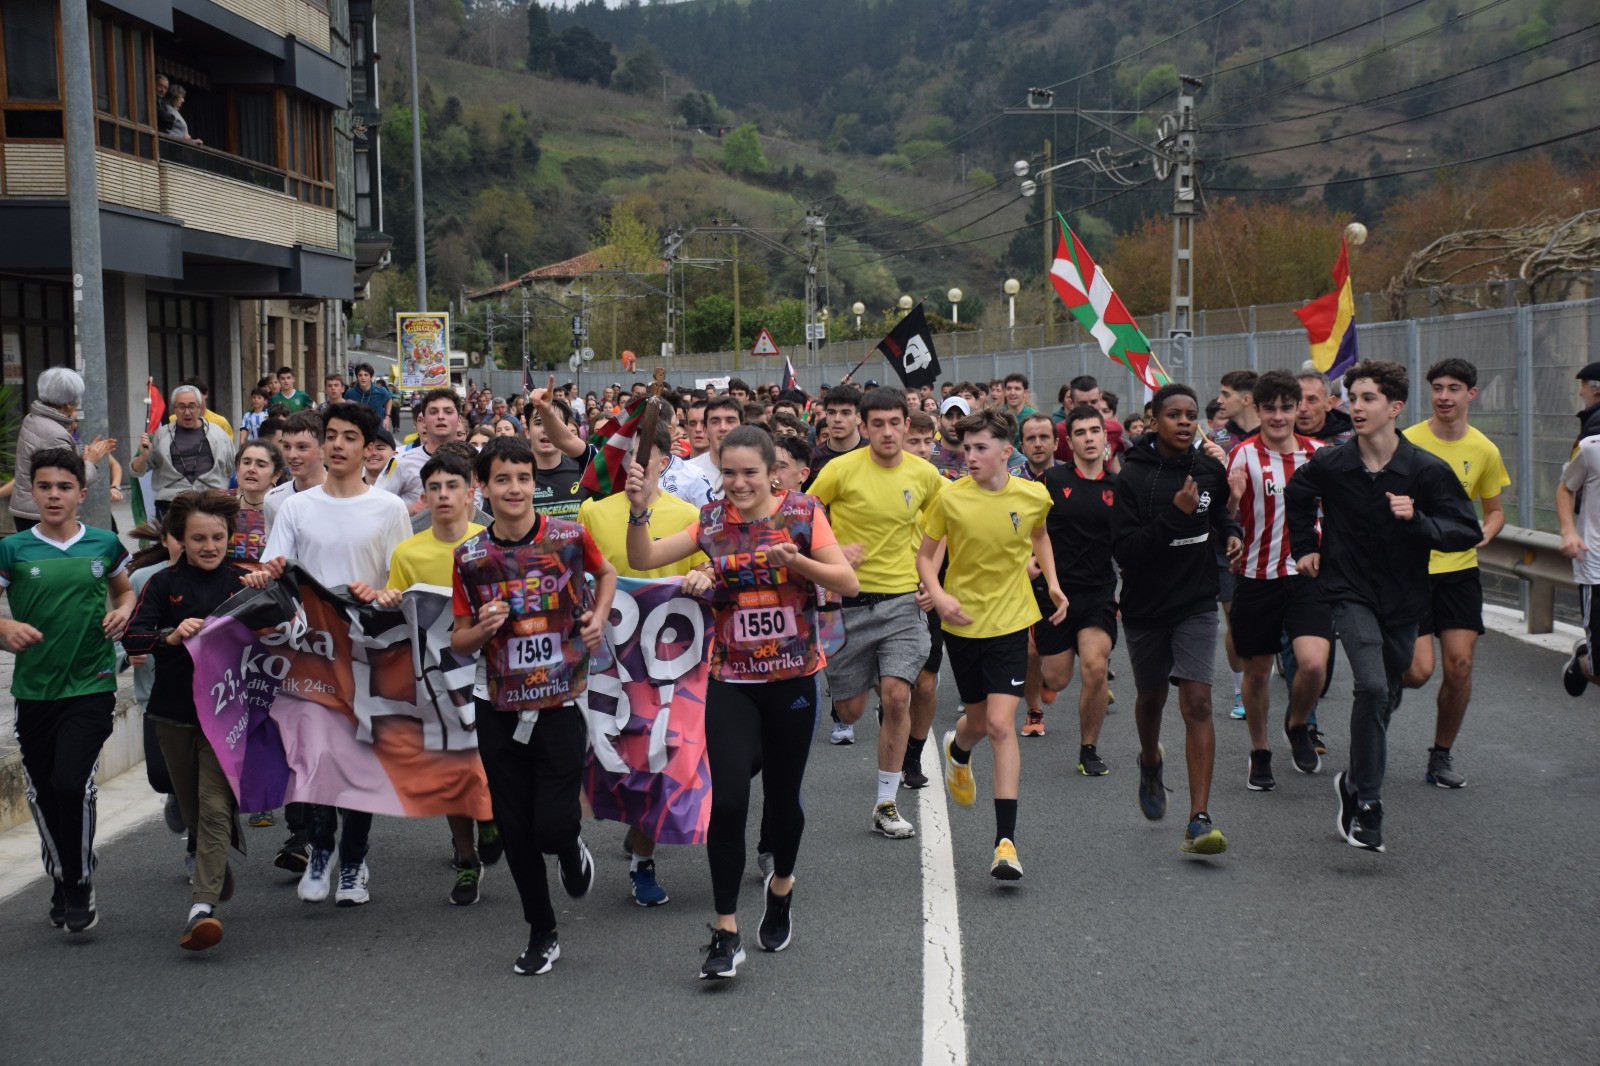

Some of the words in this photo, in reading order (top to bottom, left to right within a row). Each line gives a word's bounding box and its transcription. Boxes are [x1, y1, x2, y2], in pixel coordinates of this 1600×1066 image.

[560, 530, 579, 539] eitb
[740, 610, 785, 637] 1550
[516, 637, 552, 664] 1549
[753, 642, 780, 658] aek
[525, 667, 550, 686] aek
[304, 679, 335, 694] 24ra
